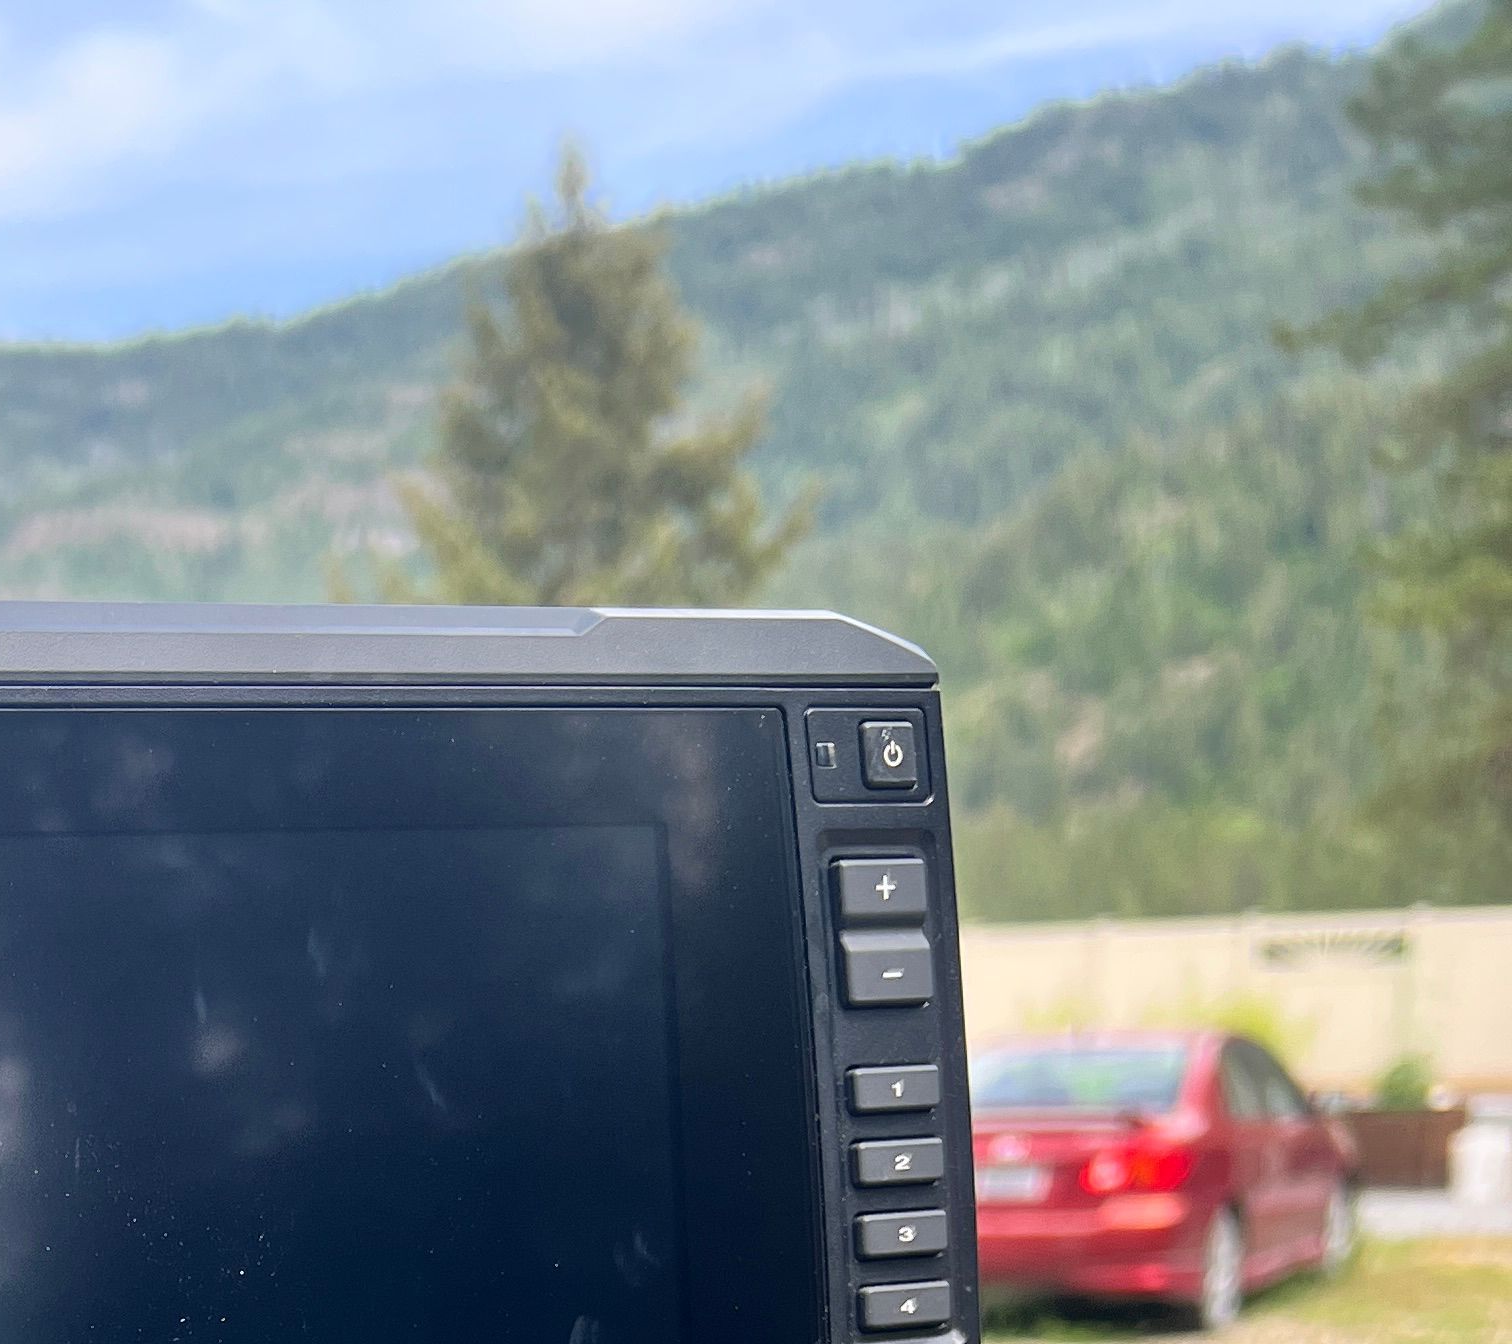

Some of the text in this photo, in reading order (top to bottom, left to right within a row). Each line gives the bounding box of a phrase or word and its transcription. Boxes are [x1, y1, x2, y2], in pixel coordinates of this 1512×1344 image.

[892, 1081, 905, 1098] 1
[894, 1154, 911, 1170] 2
[898, 1226, 915, 1242] 3
[899, 1298, 917, 1315] 4
